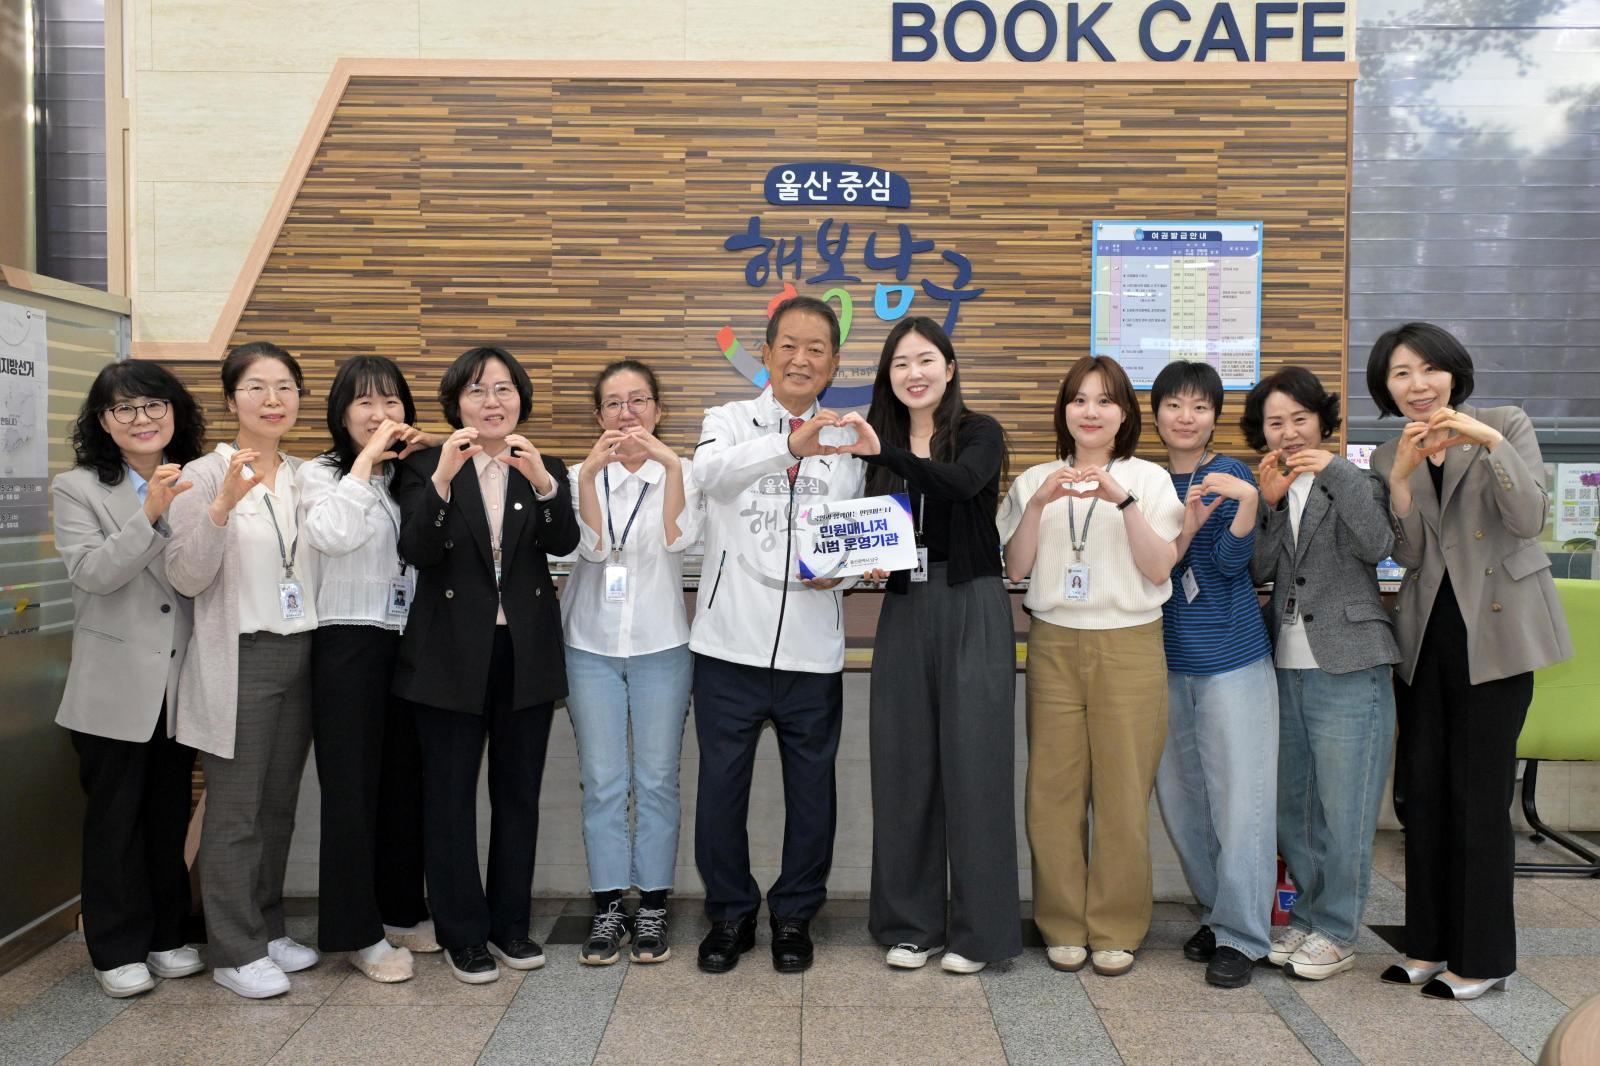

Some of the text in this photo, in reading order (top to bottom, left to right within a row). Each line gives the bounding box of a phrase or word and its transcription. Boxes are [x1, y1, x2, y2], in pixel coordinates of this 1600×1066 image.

[892, 0, 1346, 62] BOOK CAFE
[775, 170, 890, 202] 울산 중심
[0, 357, 35, 378] 지방선거
[819, 518, 888, 539] 민원매니저
[813, 532, 899, 554] 시범 운영기관
